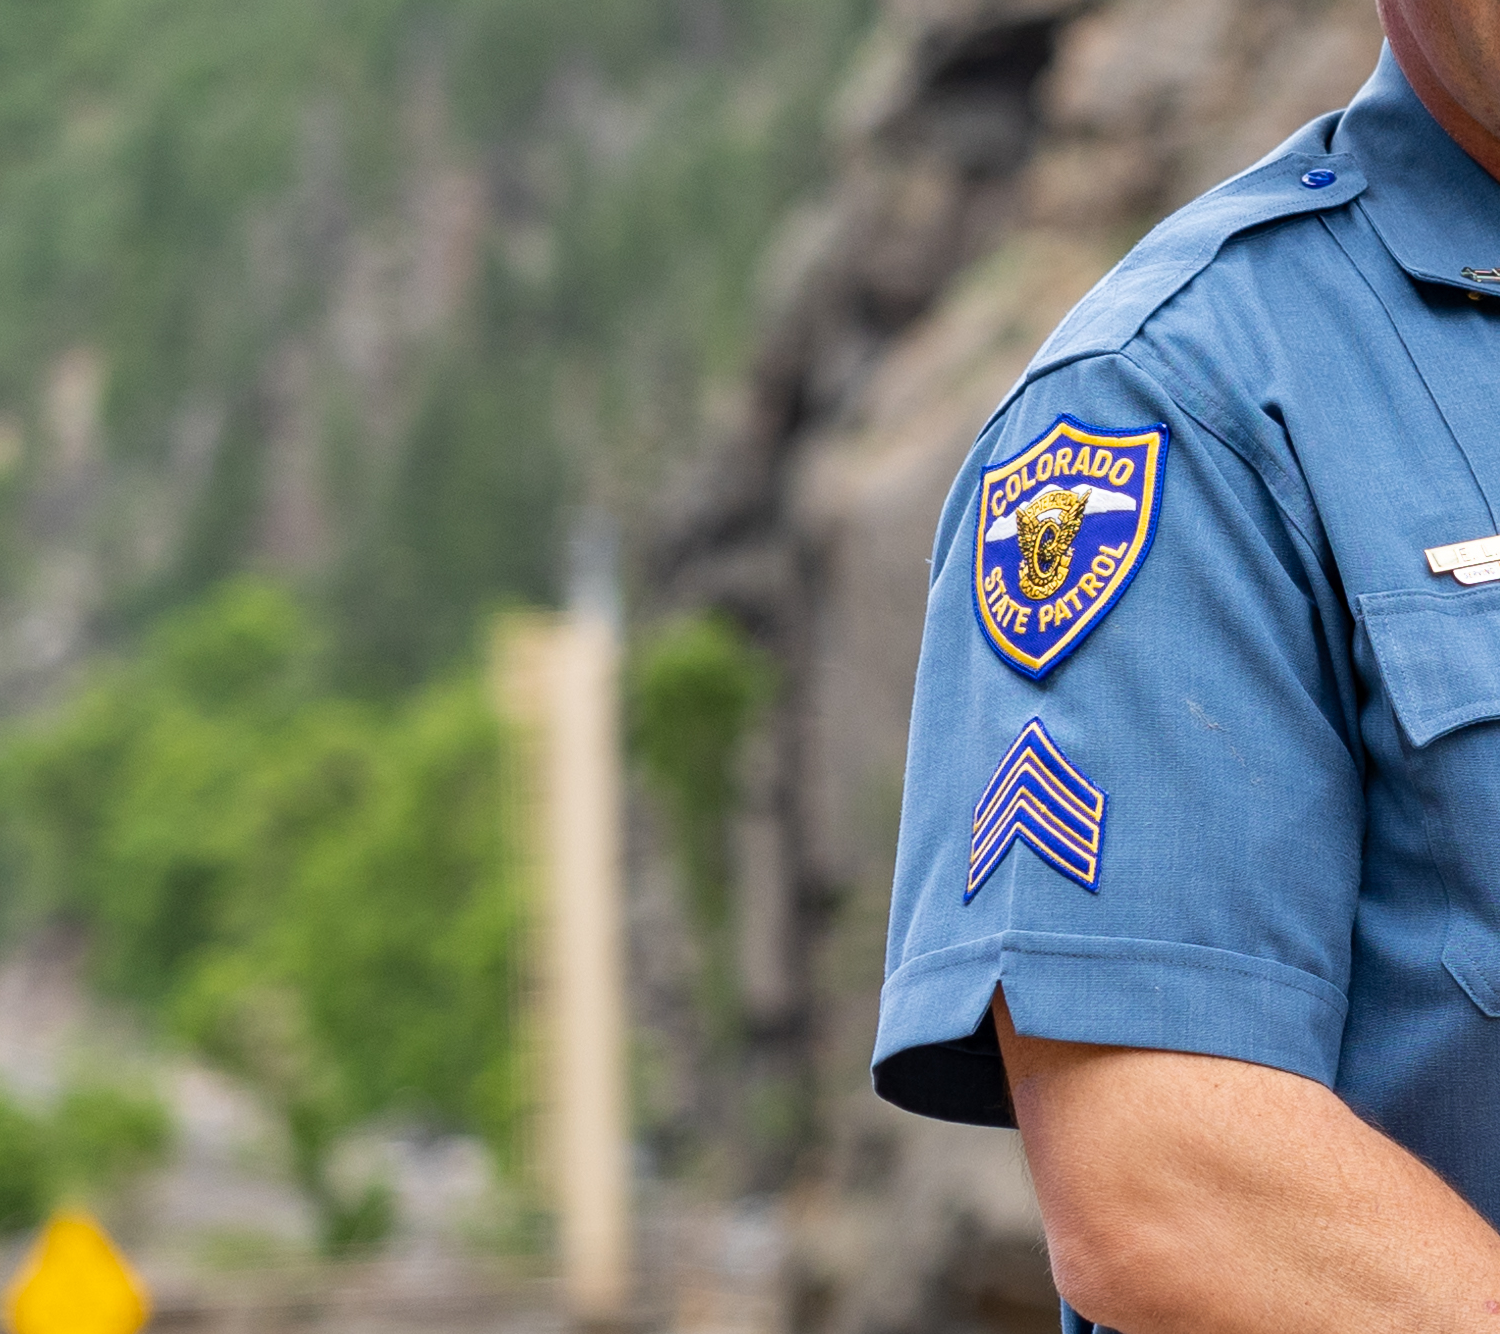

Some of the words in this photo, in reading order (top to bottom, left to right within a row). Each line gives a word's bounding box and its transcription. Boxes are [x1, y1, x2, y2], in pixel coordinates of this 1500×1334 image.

[990, 446, 1135, 517] COLORADO
[985, 567, 1032, 634] STATE
[1038, 541, 1128, 633] PATROL
[1458, 547, 1476, 563] E.
[1482, 543, 1498, 558] L.
